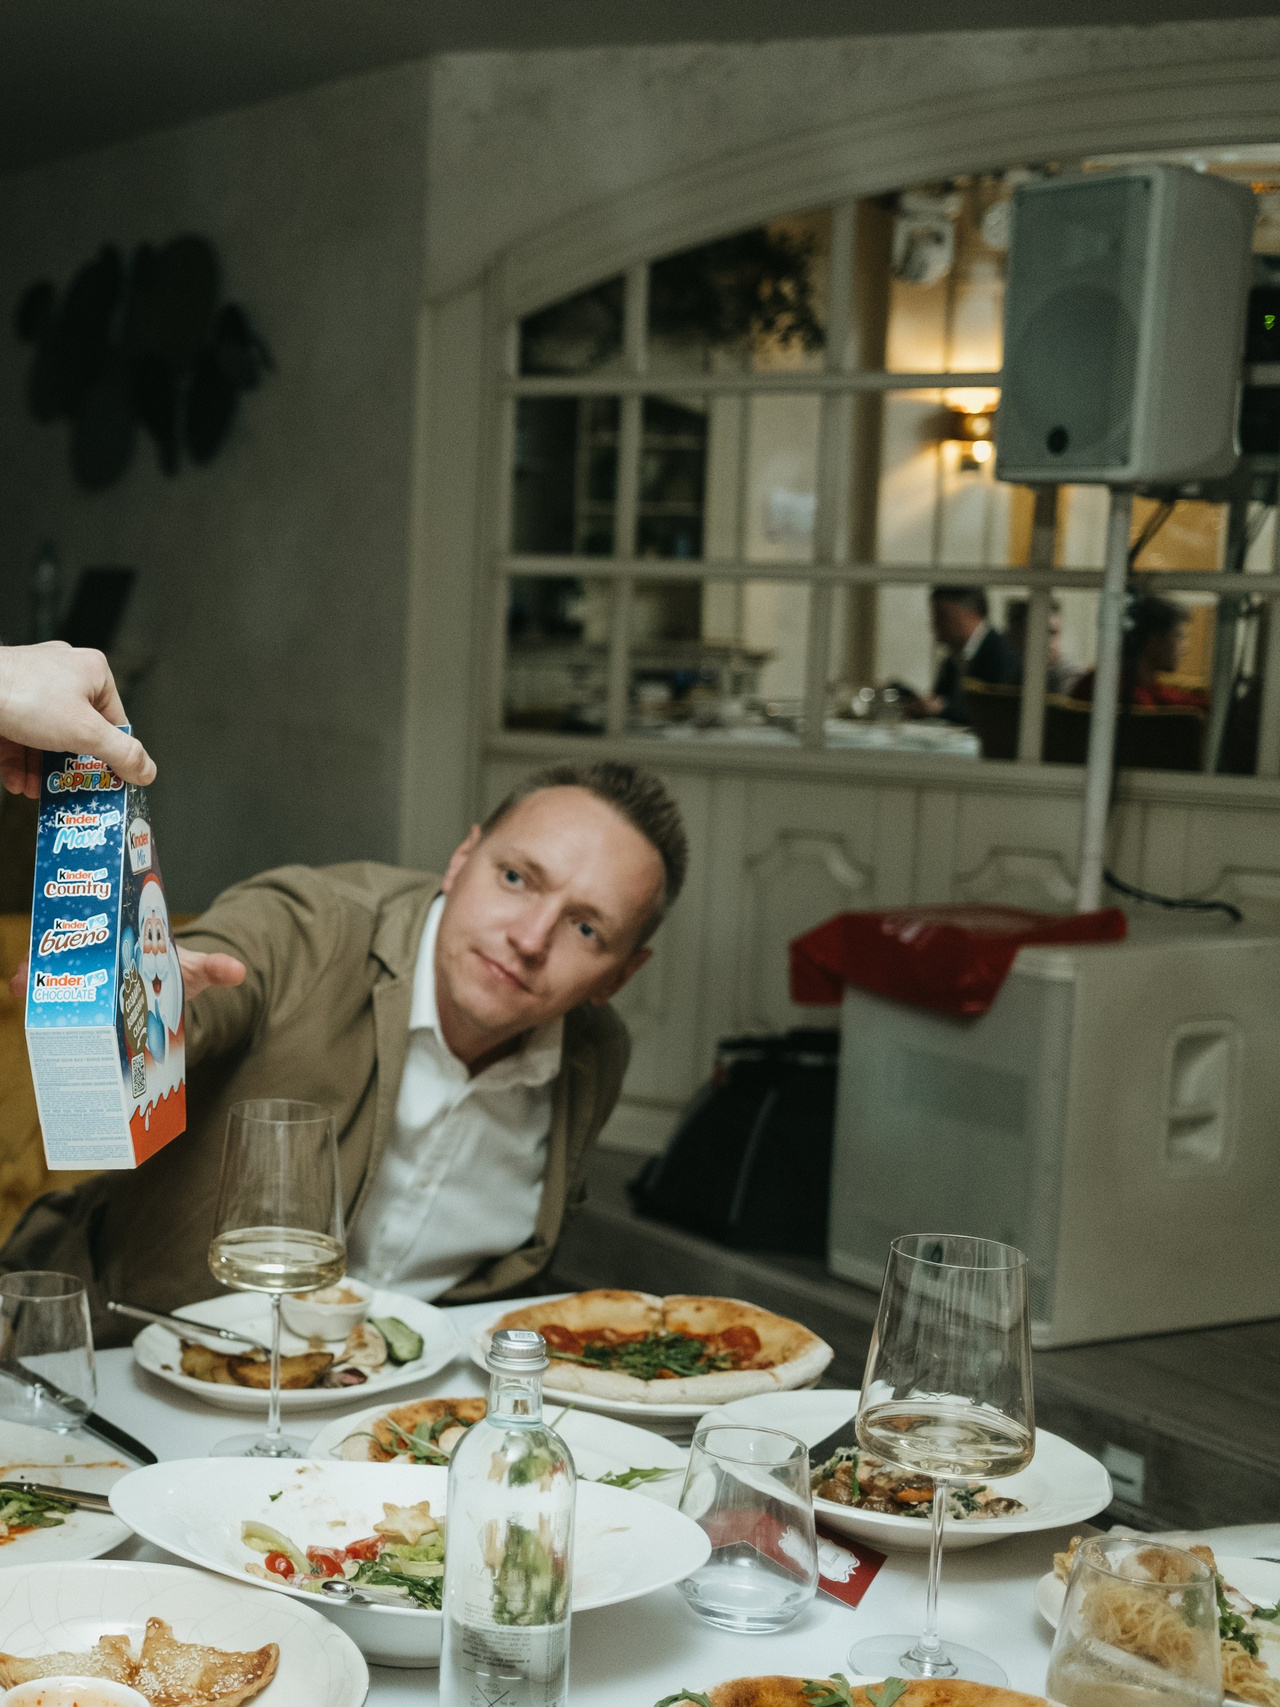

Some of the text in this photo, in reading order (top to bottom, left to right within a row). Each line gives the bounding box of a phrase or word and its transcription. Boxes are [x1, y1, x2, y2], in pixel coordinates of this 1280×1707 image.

[48, 770, 124, 792] СЮРПРИЗ
[54, 828, 104, 852] Maxi
[46, 881, 110, 898] Country
[40, 930, 108, 954] bueno
